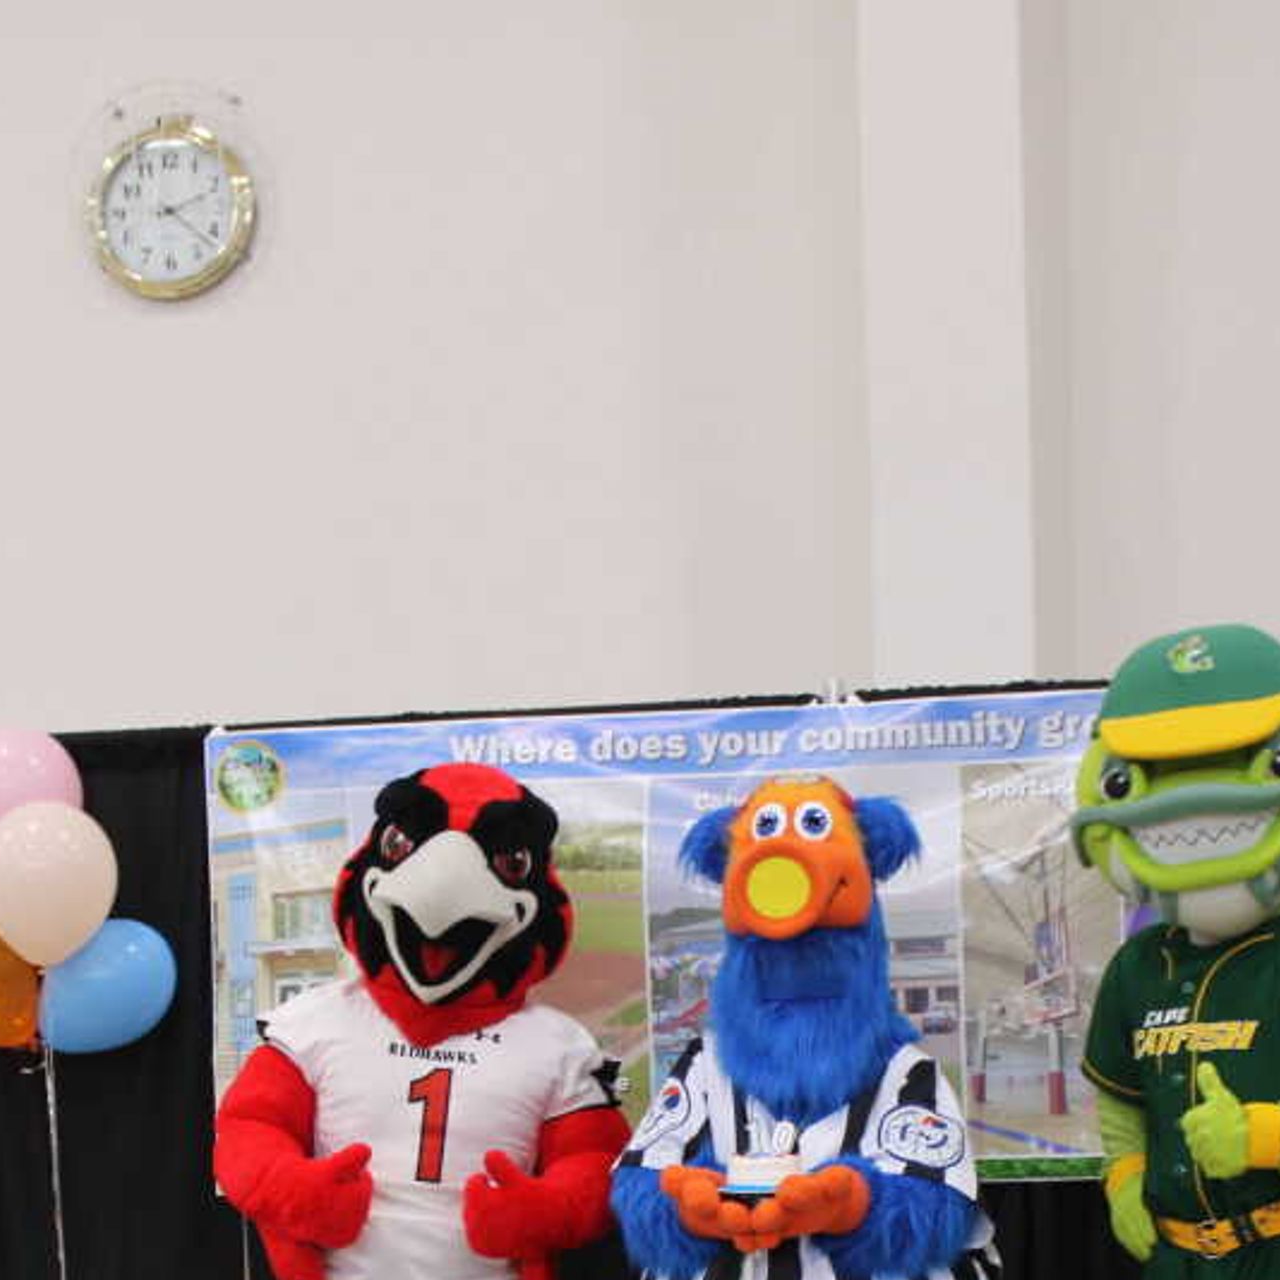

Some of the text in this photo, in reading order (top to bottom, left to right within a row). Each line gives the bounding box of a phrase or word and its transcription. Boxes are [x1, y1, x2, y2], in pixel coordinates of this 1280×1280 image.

[448, 731, 578, 765] Where
[589, 729, 689, 762] does
[696, 728, 789, 765] your
[799, 710, 1028, 753] community
[389, 1040, 480, 1065] REDHAWKS
[407, 1067, 454, 1183] 1
